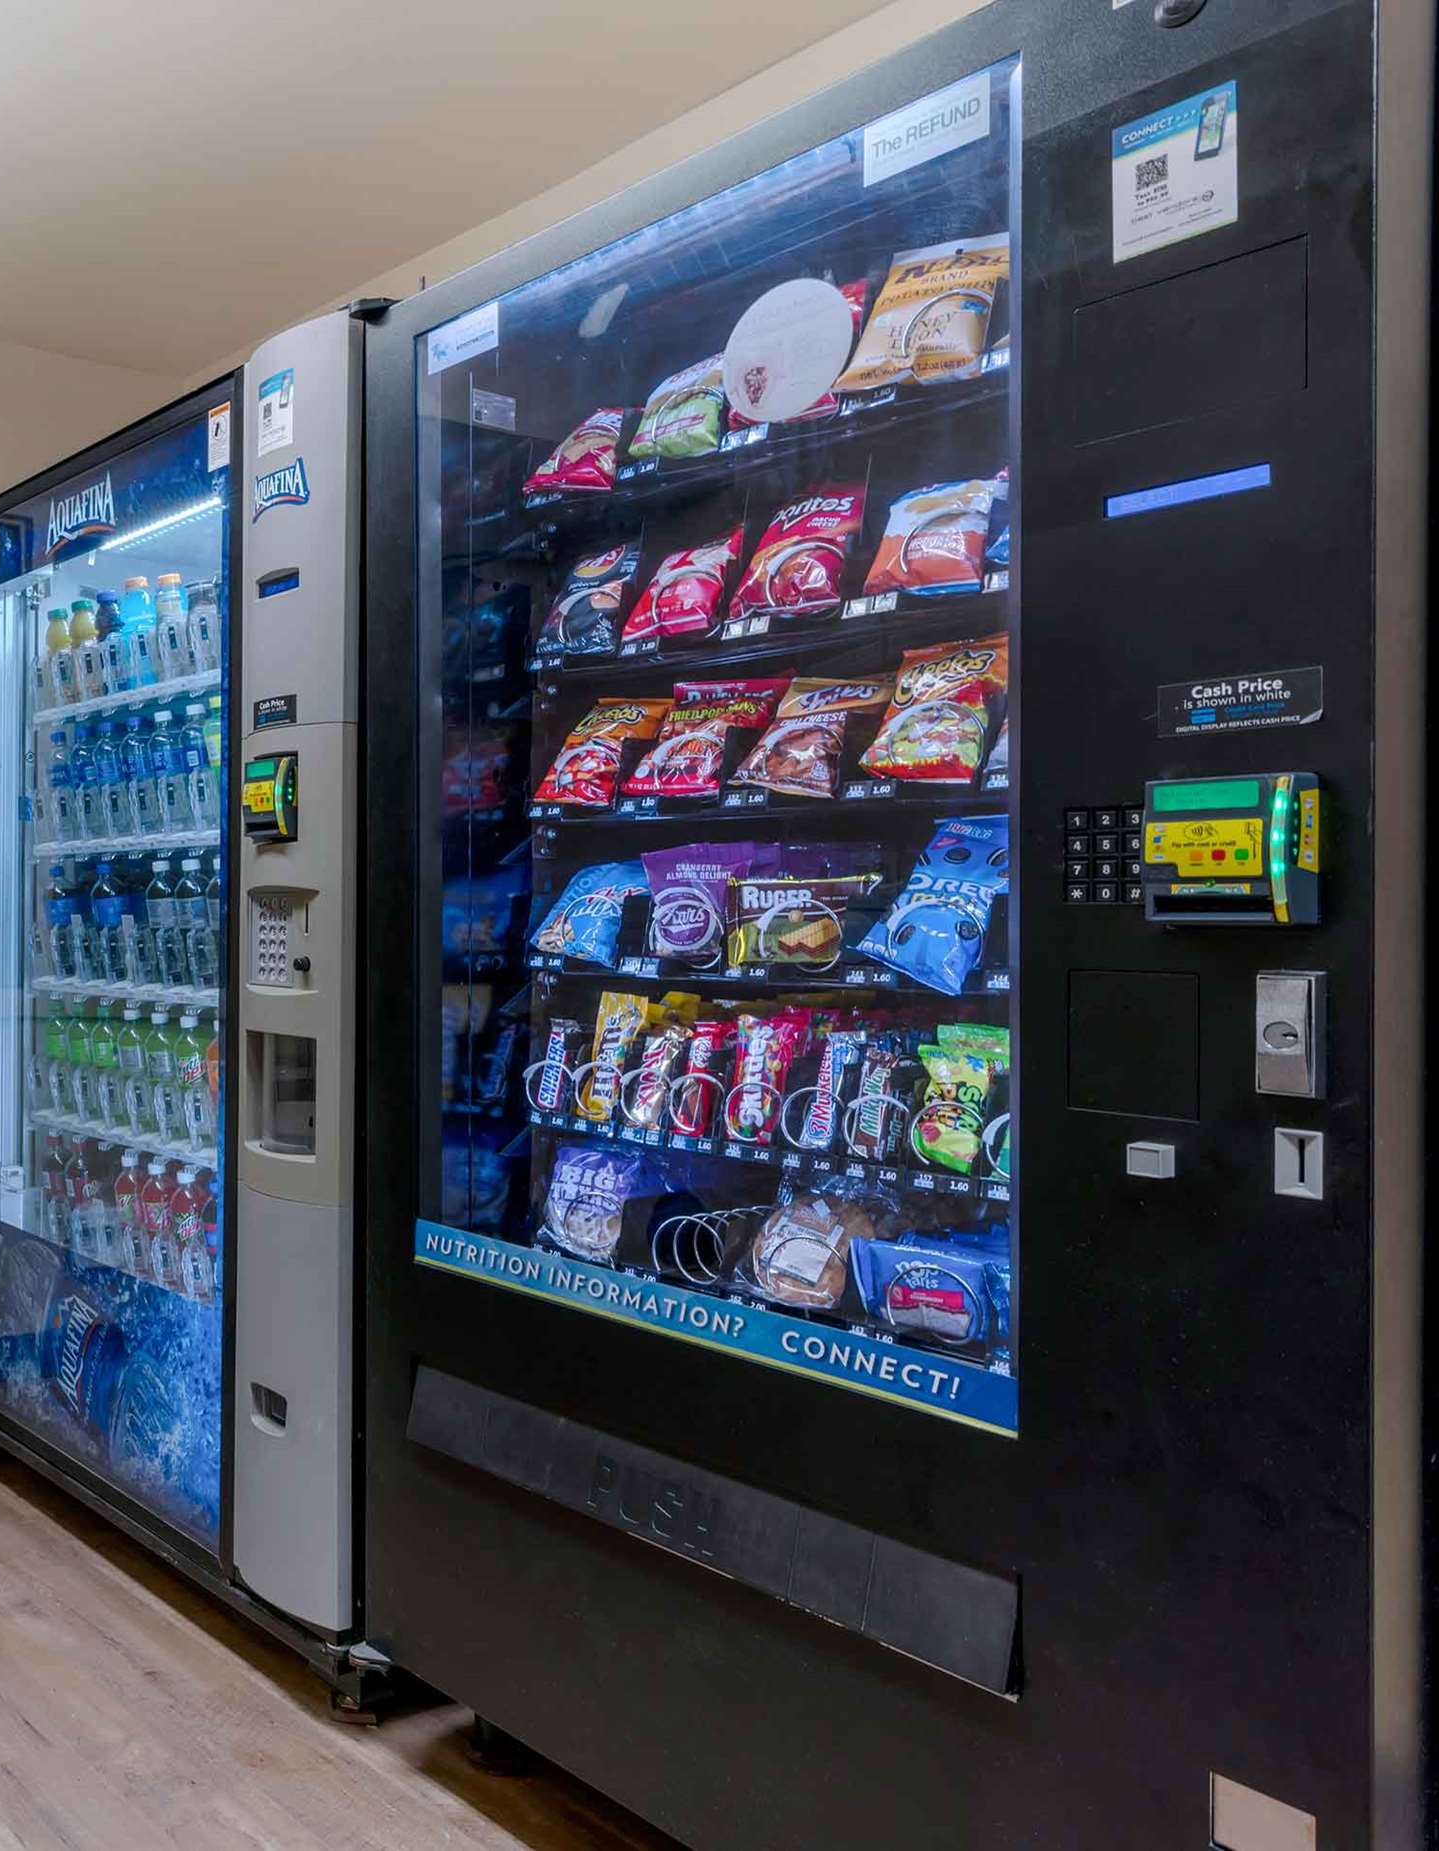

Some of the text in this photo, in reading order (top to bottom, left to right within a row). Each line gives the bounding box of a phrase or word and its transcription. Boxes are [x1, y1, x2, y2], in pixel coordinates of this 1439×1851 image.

[872, 97, 981, 158] The REFUND
[1122, 115, 1174, 143] CONNECT
[253, 459, 308, 510] AQUAFINA
[45, 469, 116, 554] AQUAFINA
[768, 496, 855, 532] Doritos
[1191, 678, 1284, 699] Cash Price
[1183, 688, 1292, 710] is shown in white
[1175, 714, 1301, 734] DIGITAL DISPLAY REFLECTS CASH PRICE
[872, 784, 892, 795] 1.60
[746, 793, 765, 804] 1.60
[1073, 814, 1140, 827] 1 2 3
[1073, 839, 1140, 851] 4 5 6
[666, 871, 732, 881] ALMOND DELIGHT
[1073, 864, 1140, 876] 7 8 9
[742, 885, 813, 910] RUGER
[1102, 888, 1141, 899] 0 #
[749, 966, 767, 978] 1.60
[872, 972, 892, 983] 1.60
[539, 1033, 563, 1107] SNICKERS
[697, 1140, 712, 1151] 1.60
[753, 1150, 770, 1161] 1.60
[813, 1159, 831, 1171] 1.60
[560, 1165, 617, 1193] BIG
[879, 1169, 898, 1182] 1.60
[949, 1180, 969, 1193] 1.60
[426, 1232, 746, 1338] NUTRITION INFORMATION?
[751, 1301, 766, 1312] 2.00
[875, 1332, 894, 1344] 1.60
[58, 1294, 99, 1412] AQUAFINA
[781, 1330, 961, 1400] CONNECT!
